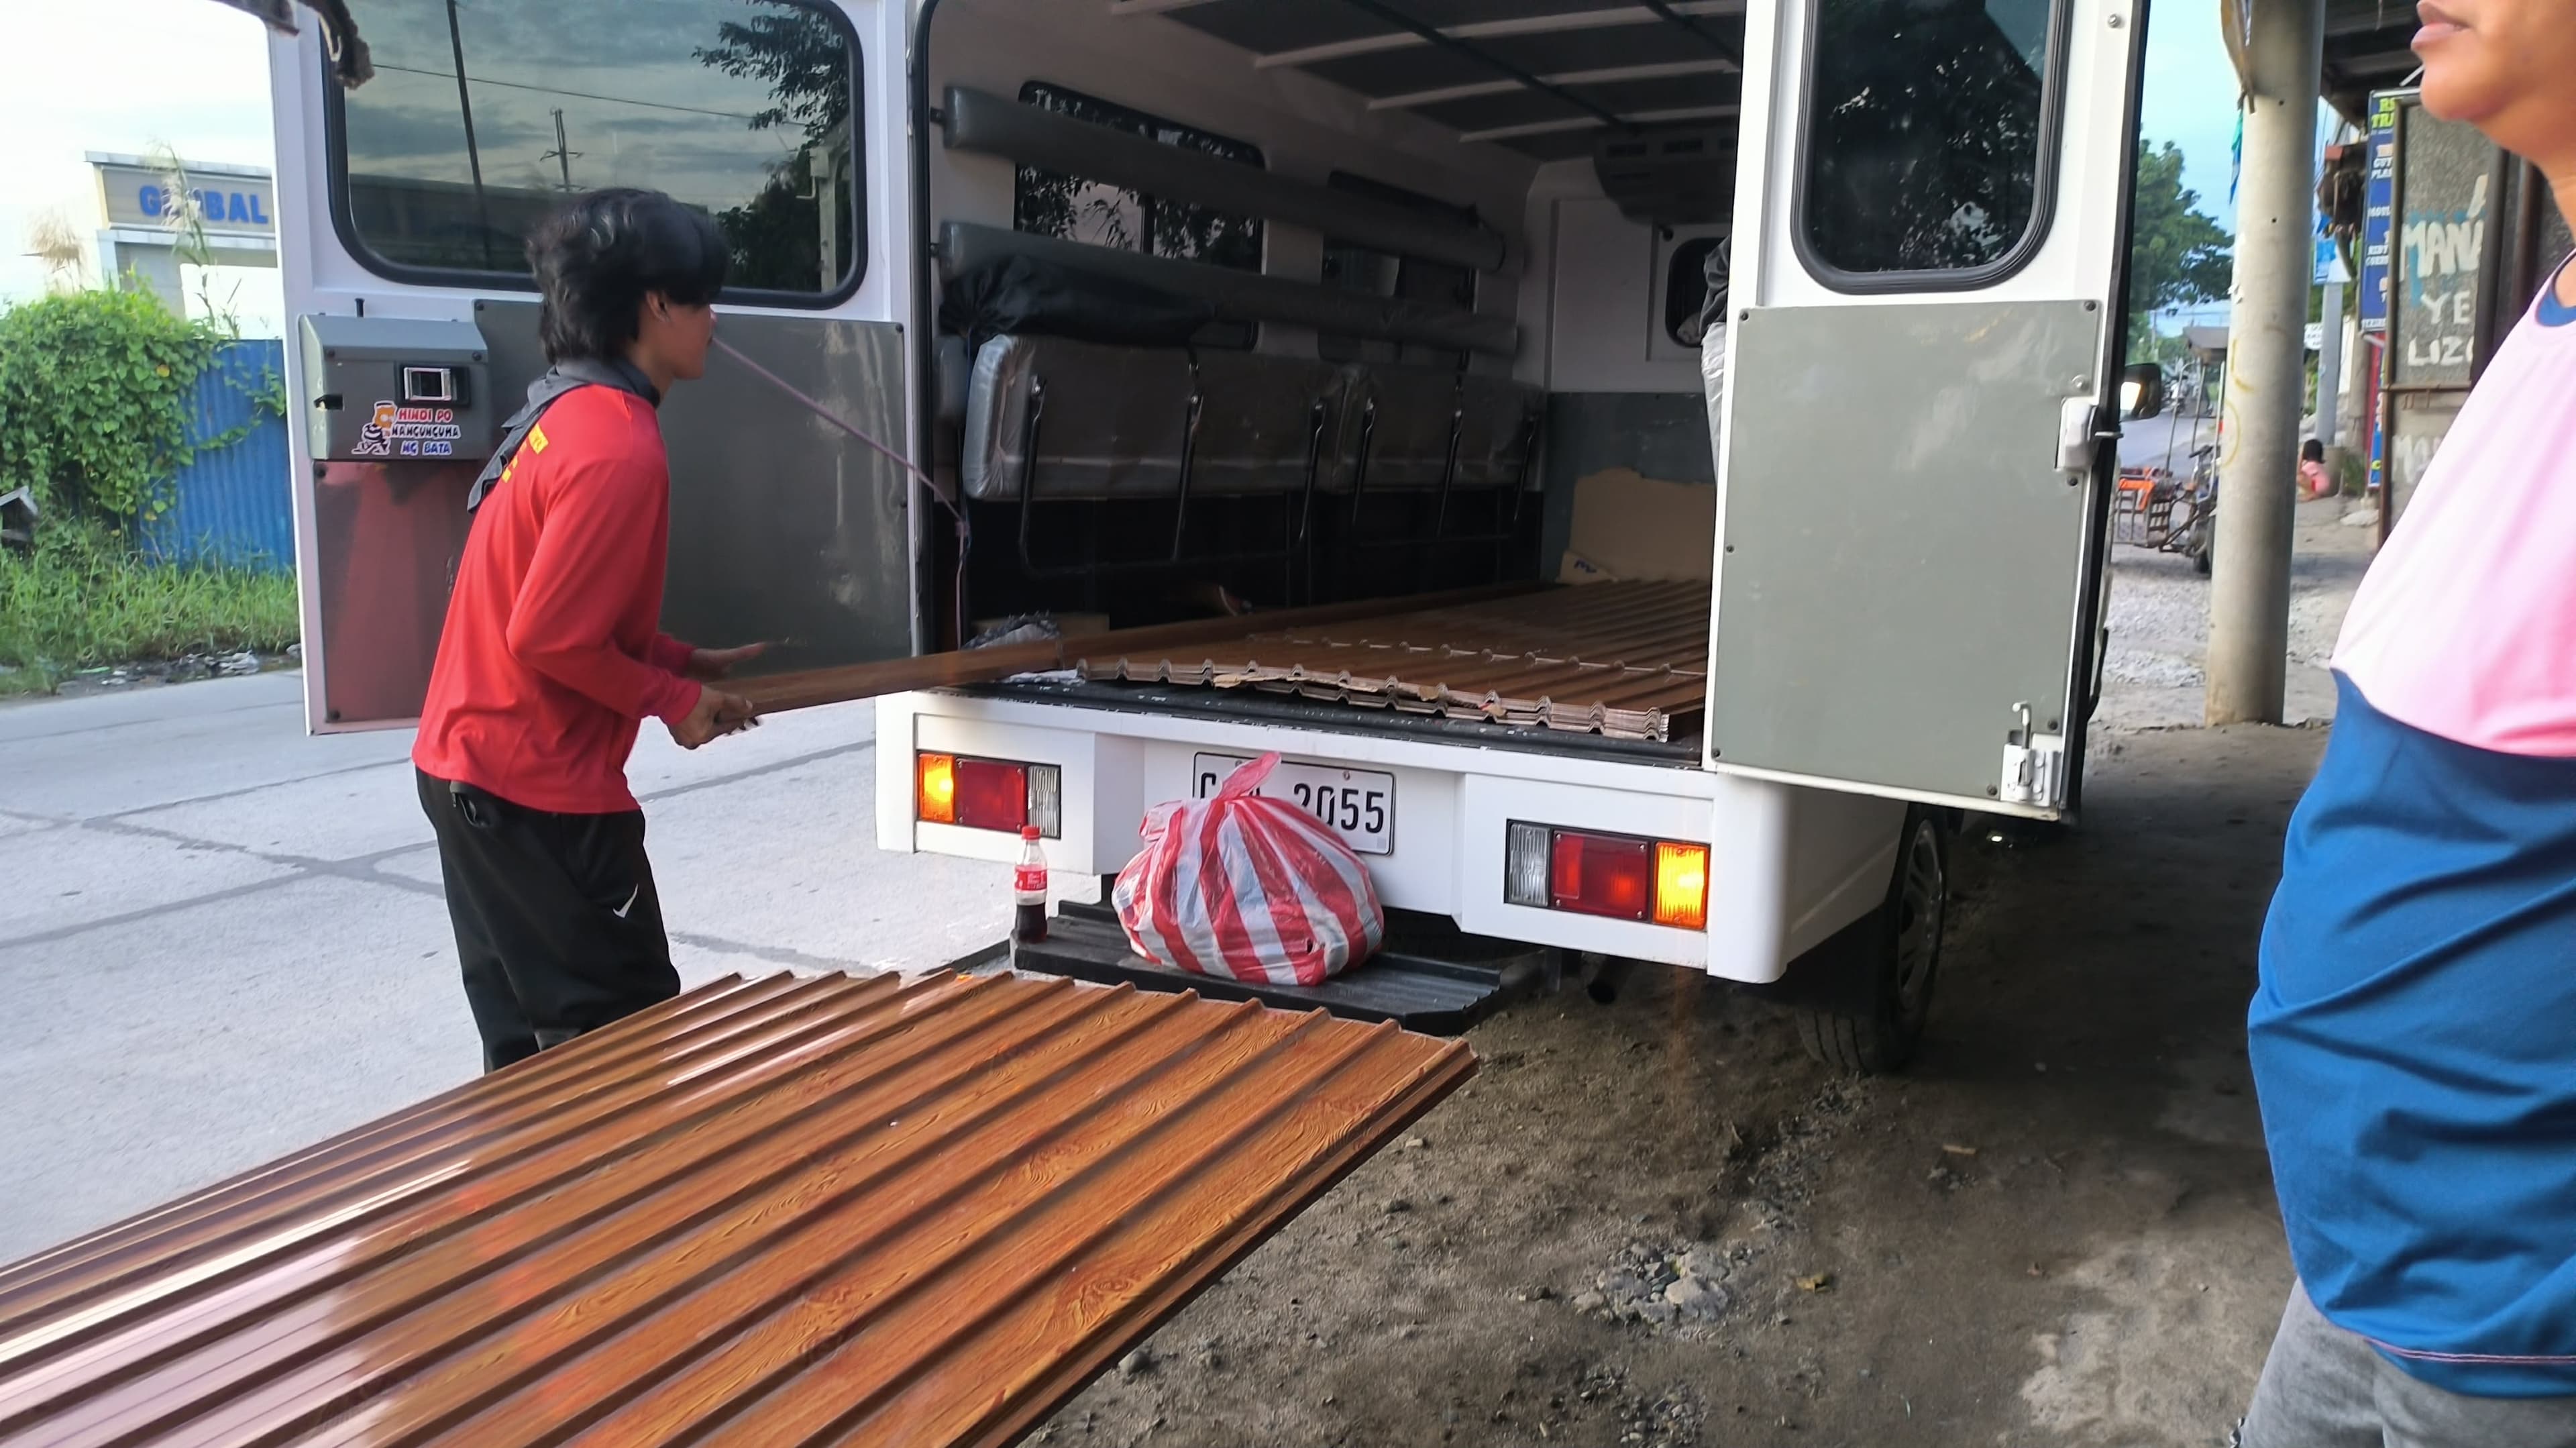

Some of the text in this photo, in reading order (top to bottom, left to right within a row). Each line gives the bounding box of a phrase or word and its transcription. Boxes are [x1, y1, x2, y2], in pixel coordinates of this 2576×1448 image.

[139, 185, 268, 224] GBAL
[398, 408, 453, 423] HINDI PO
[423, 442, 452, 455] BATA
[1293, 782, 1385, 833] 2055
